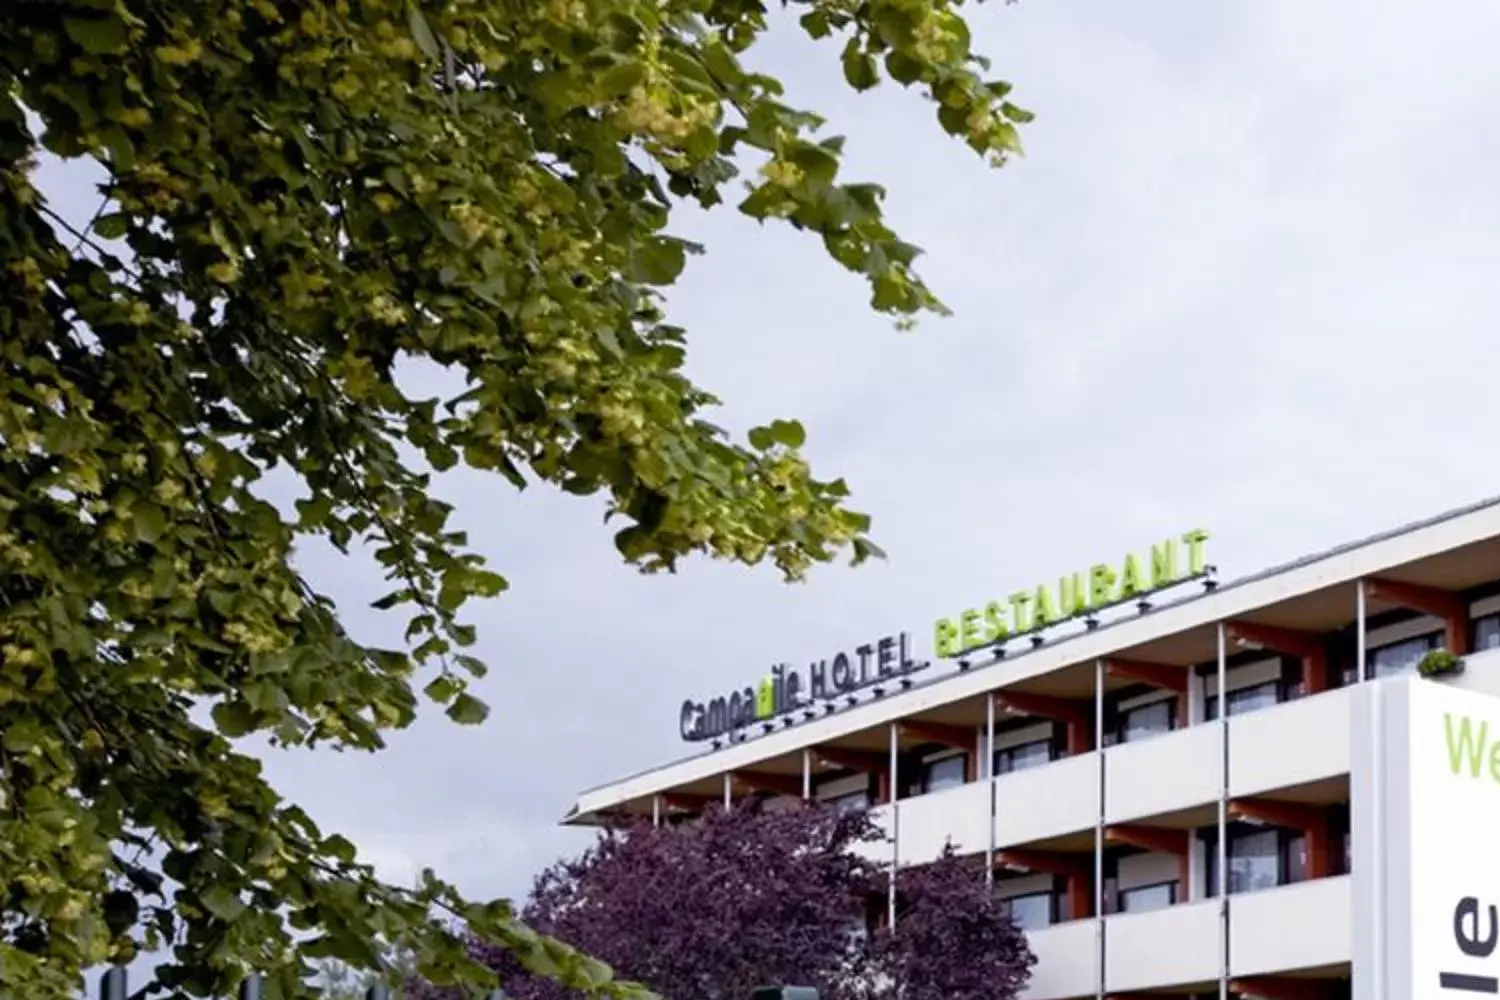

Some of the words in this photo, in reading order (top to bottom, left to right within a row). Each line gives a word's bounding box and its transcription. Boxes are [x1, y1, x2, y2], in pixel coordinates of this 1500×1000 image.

[680, 664, 799, 743] Campanile
[810, 631, 912, 700] HOTEL
[934, 529, 1210, 659] RESTAURANT
